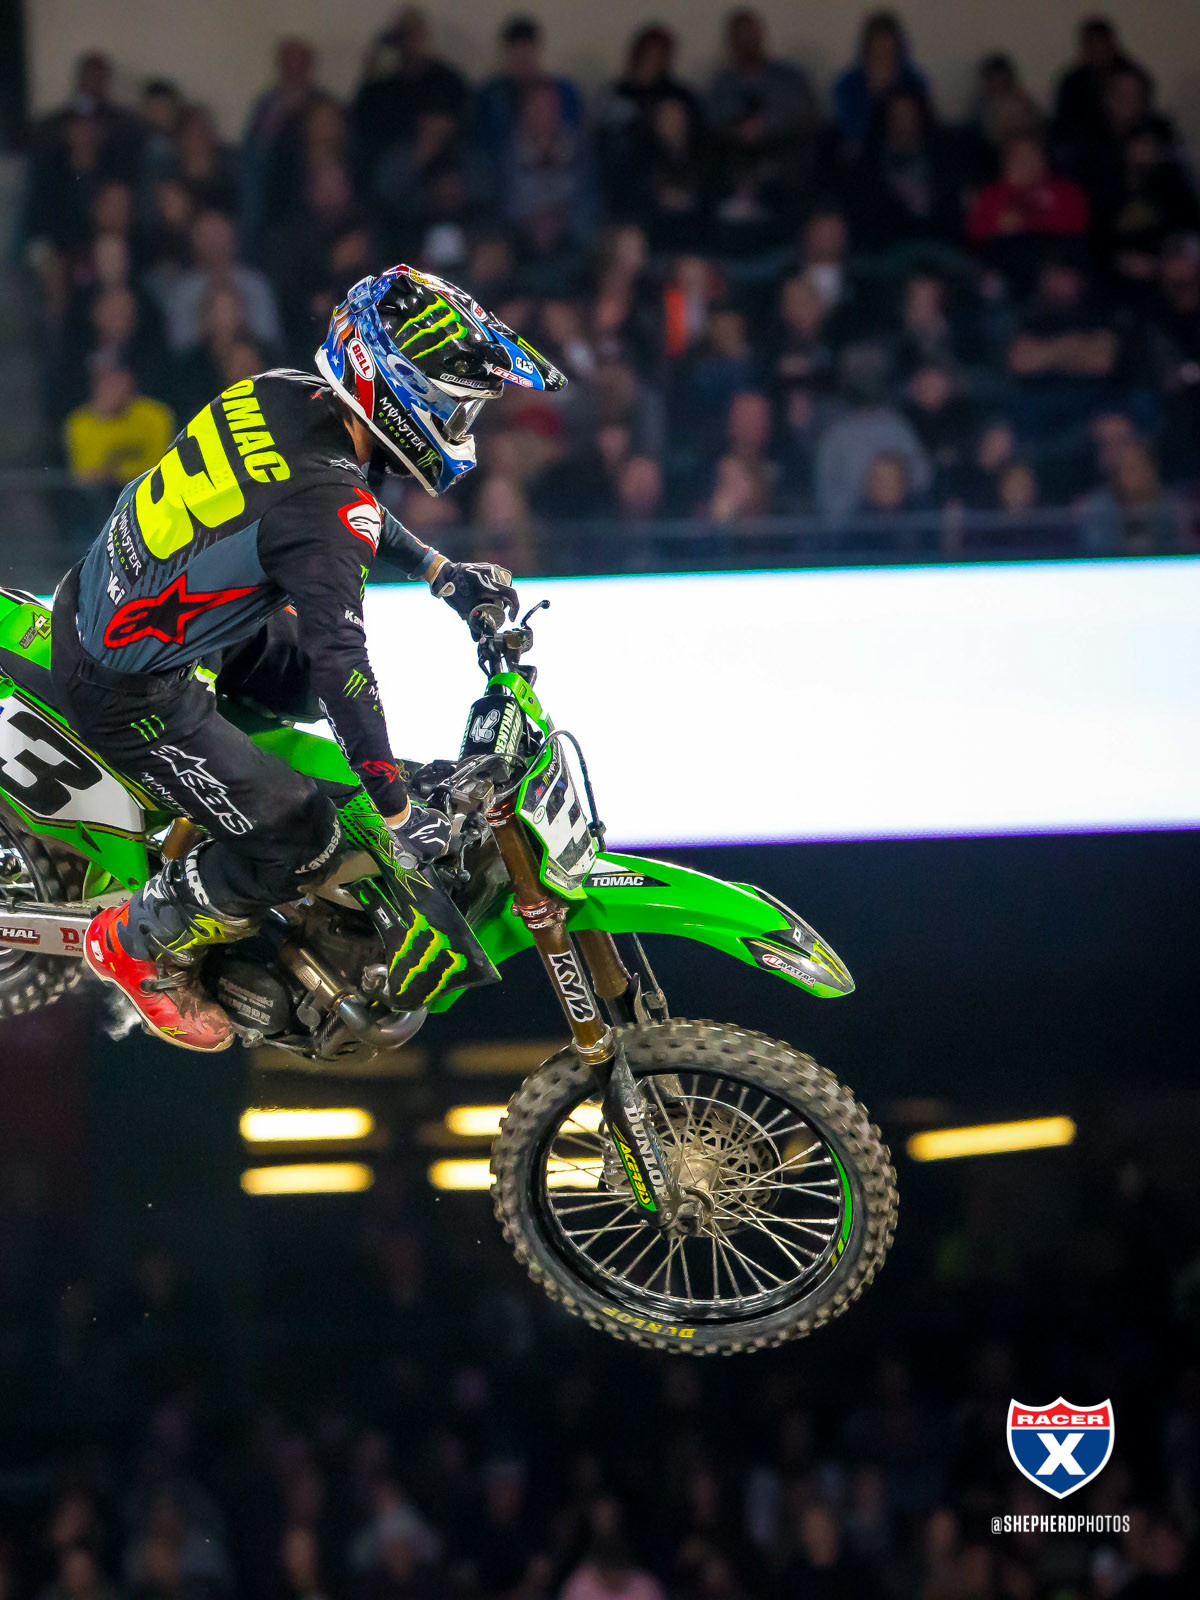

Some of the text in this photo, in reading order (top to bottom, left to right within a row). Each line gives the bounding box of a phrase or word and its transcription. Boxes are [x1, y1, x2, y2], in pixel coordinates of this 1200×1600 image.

[351, 343, 371, 375] BELL
[378, 411, 411, 448] ENERGY
[380, 397, 426, 452] MONSTER
[135, 403, 246, 560] 3
[591, 876, 645, 887] TOMAC
[619, 1141, 651, 1205] ACERBIS
[603, 1305, 696, 1339] DUNLOP
